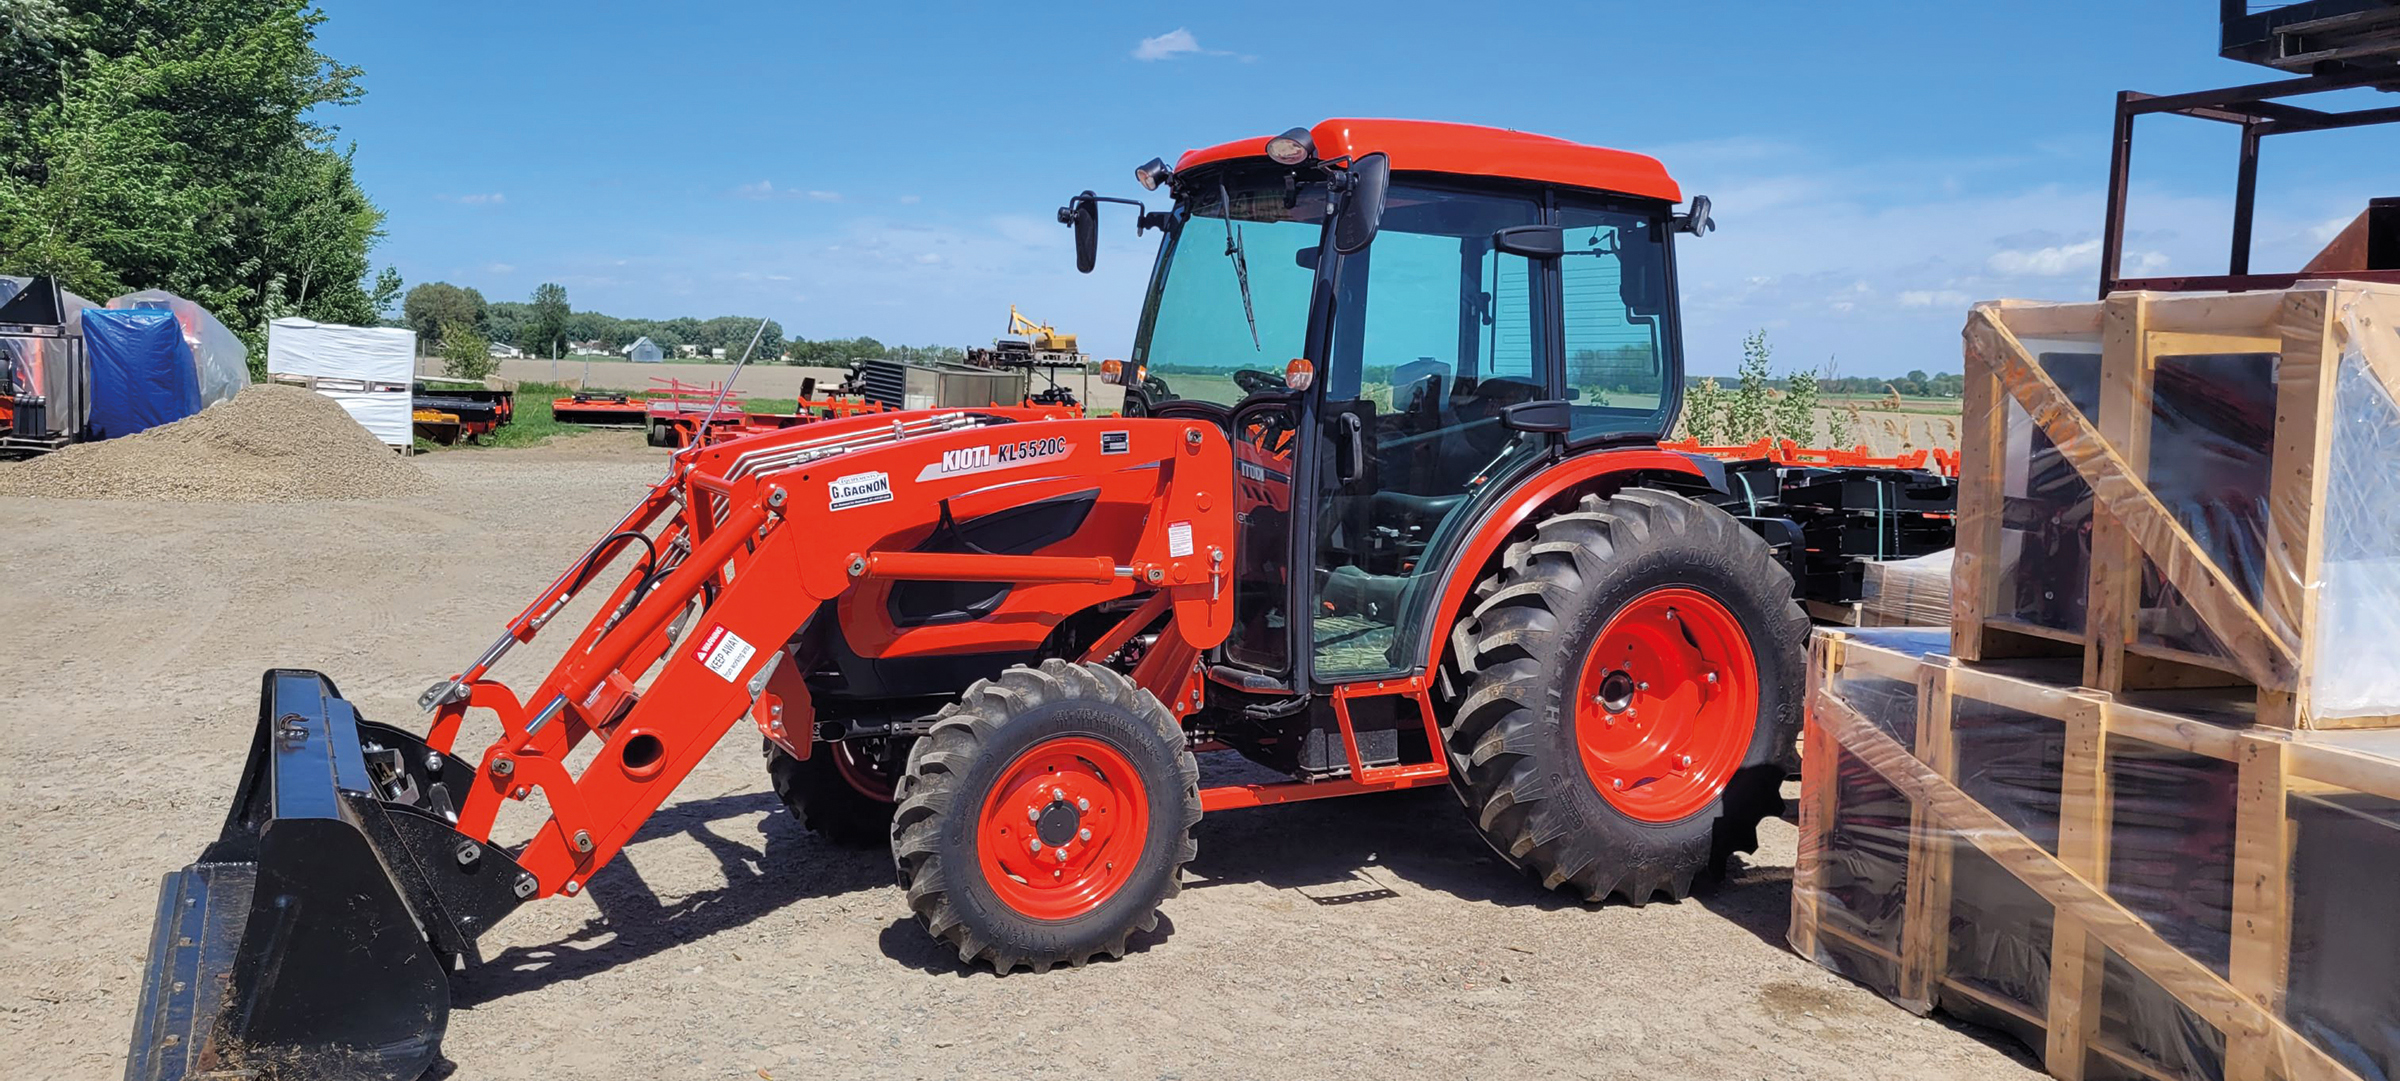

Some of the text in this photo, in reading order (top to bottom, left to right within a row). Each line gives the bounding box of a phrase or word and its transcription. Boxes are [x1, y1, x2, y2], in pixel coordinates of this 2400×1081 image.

[941, 437, 1065, 473] KIOTI KL5520C
[1686, 547, 1736, 574] LUG
[701, 626, 724, 652] WARNING
[710, 635, 739, 671] KEEP AWAY
[723, 645, 751, 678] from working area
